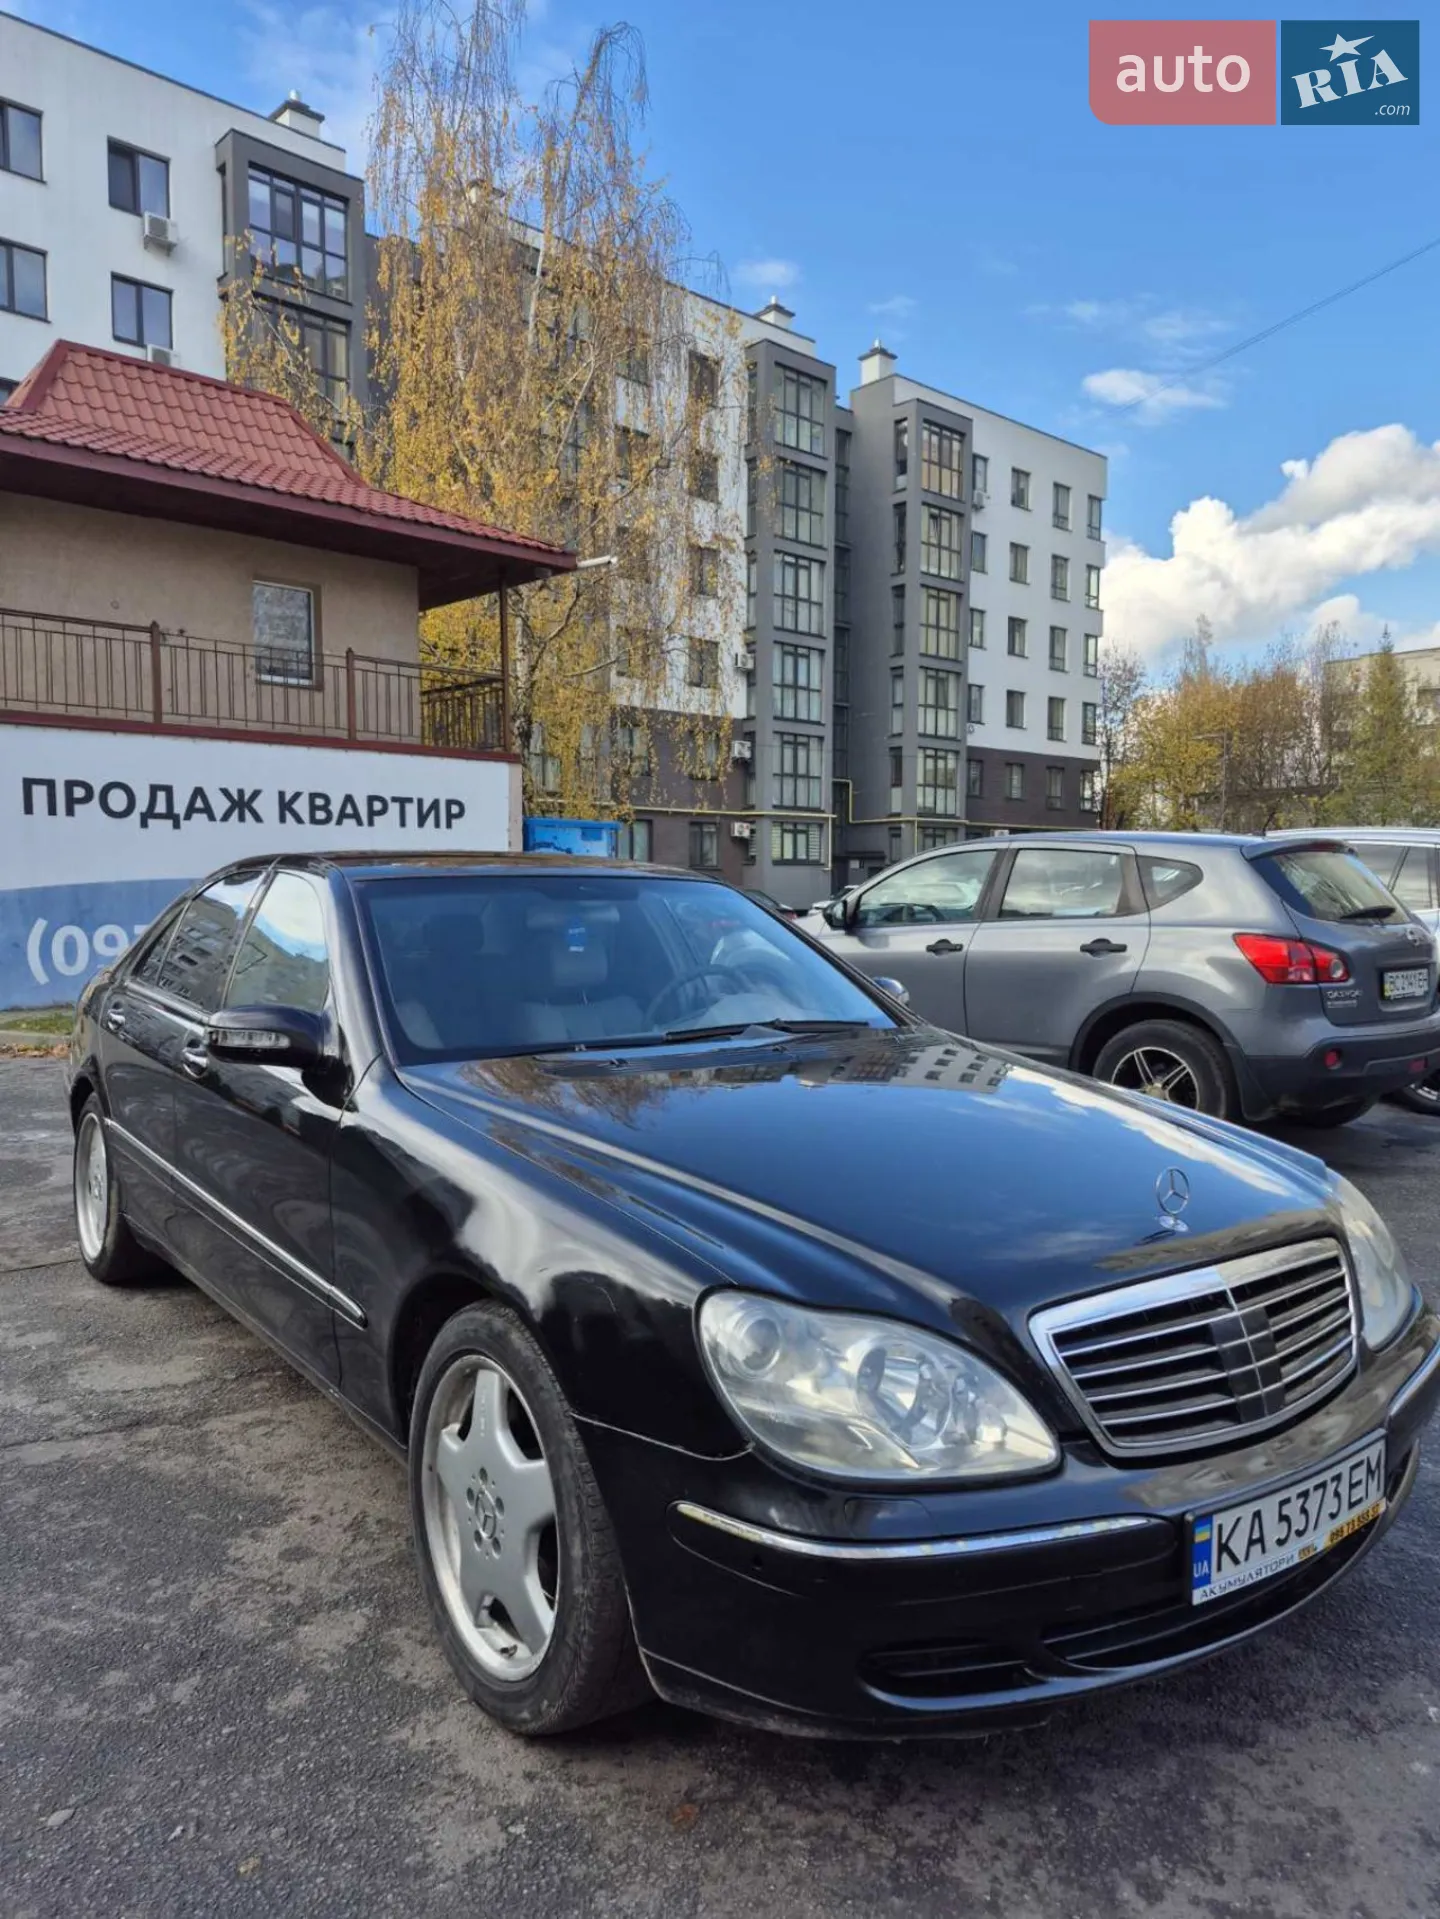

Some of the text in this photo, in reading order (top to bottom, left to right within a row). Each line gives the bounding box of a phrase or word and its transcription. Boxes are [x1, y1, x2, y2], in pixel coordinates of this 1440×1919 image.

[22, 777, 466, 829] ПРОДАЖ КВАРТИР
[27, 917, 150, 985] (09
[1193, 1561, 1210, 1578] UA
